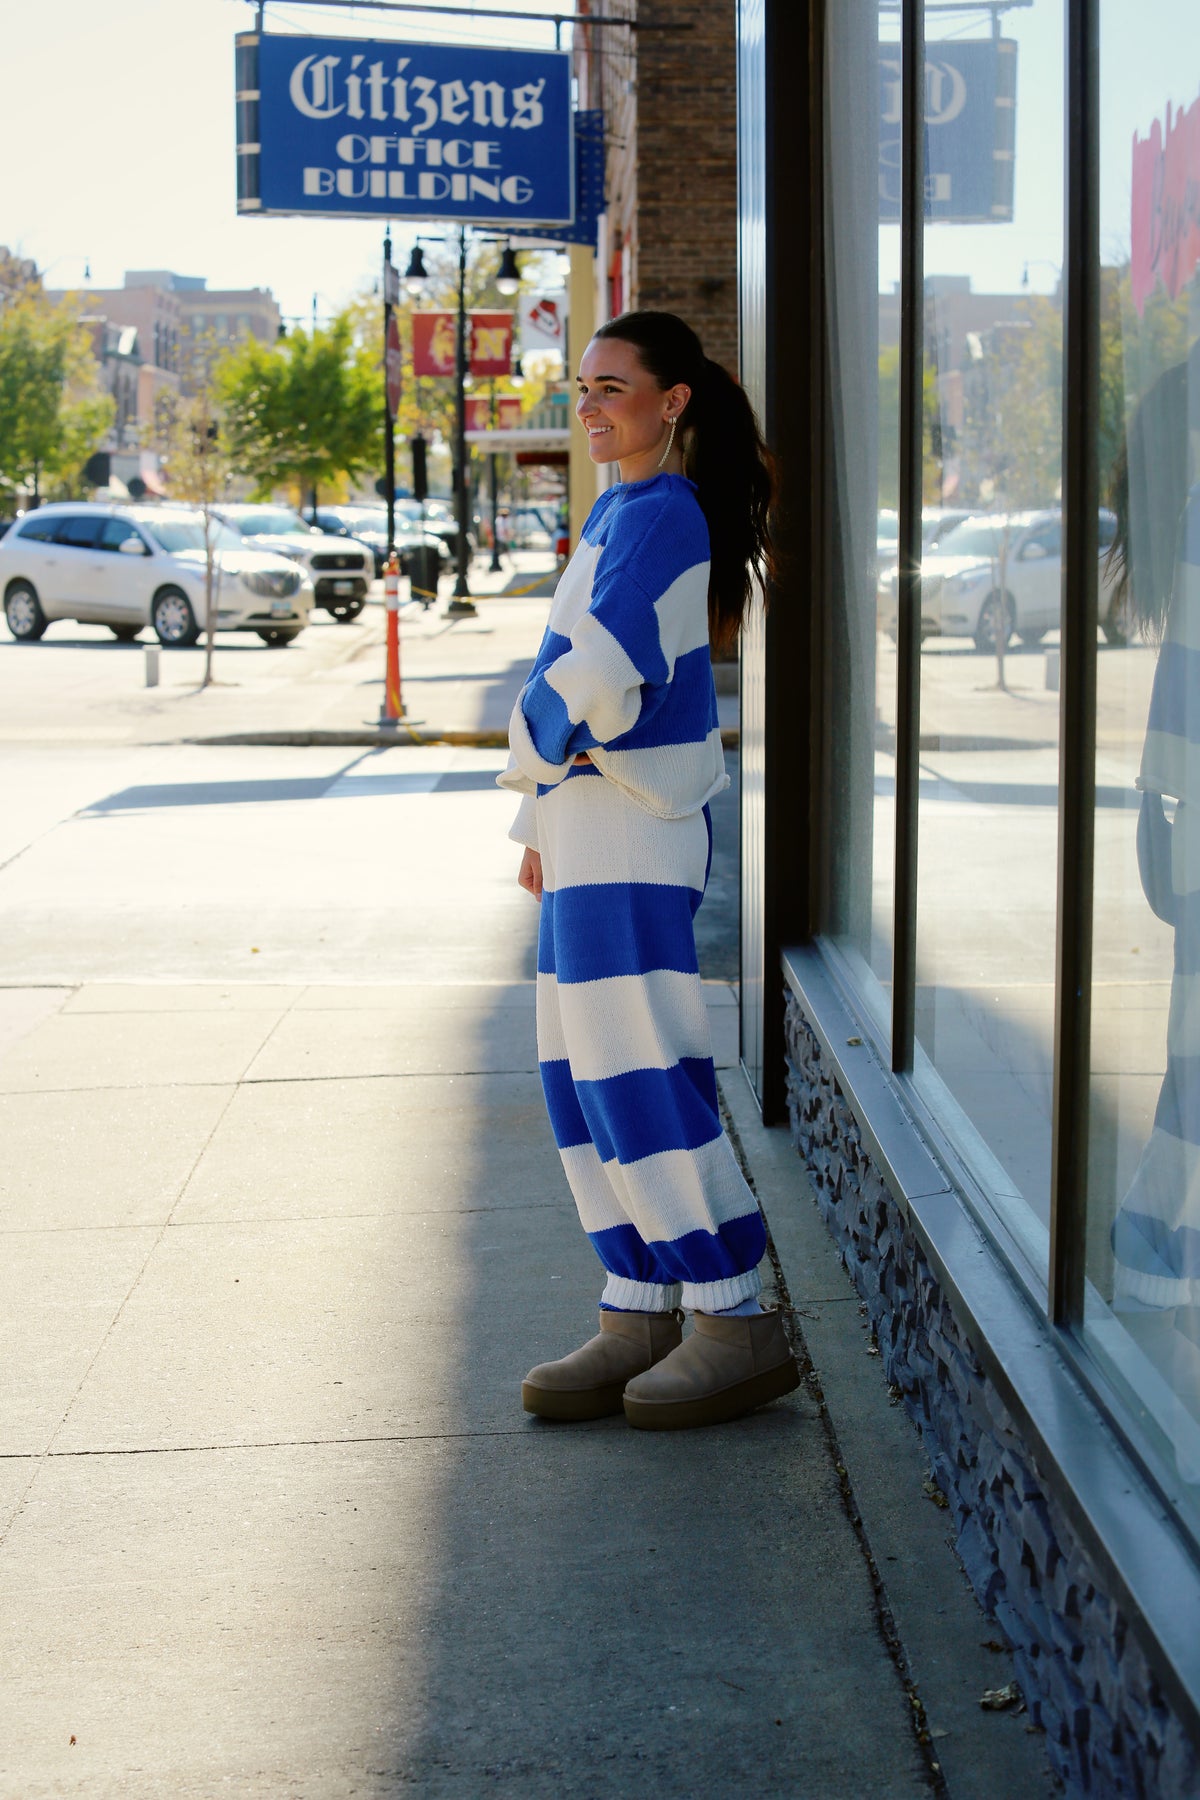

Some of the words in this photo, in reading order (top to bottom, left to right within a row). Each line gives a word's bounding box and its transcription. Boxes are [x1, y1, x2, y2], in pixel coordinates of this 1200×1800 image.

[289, 53, 546, 136] Citizens
[336, 134, 501, 168] OFFICE
[303, 167, 534, 204] BUILDING
[474, 328, 508, 361] N
